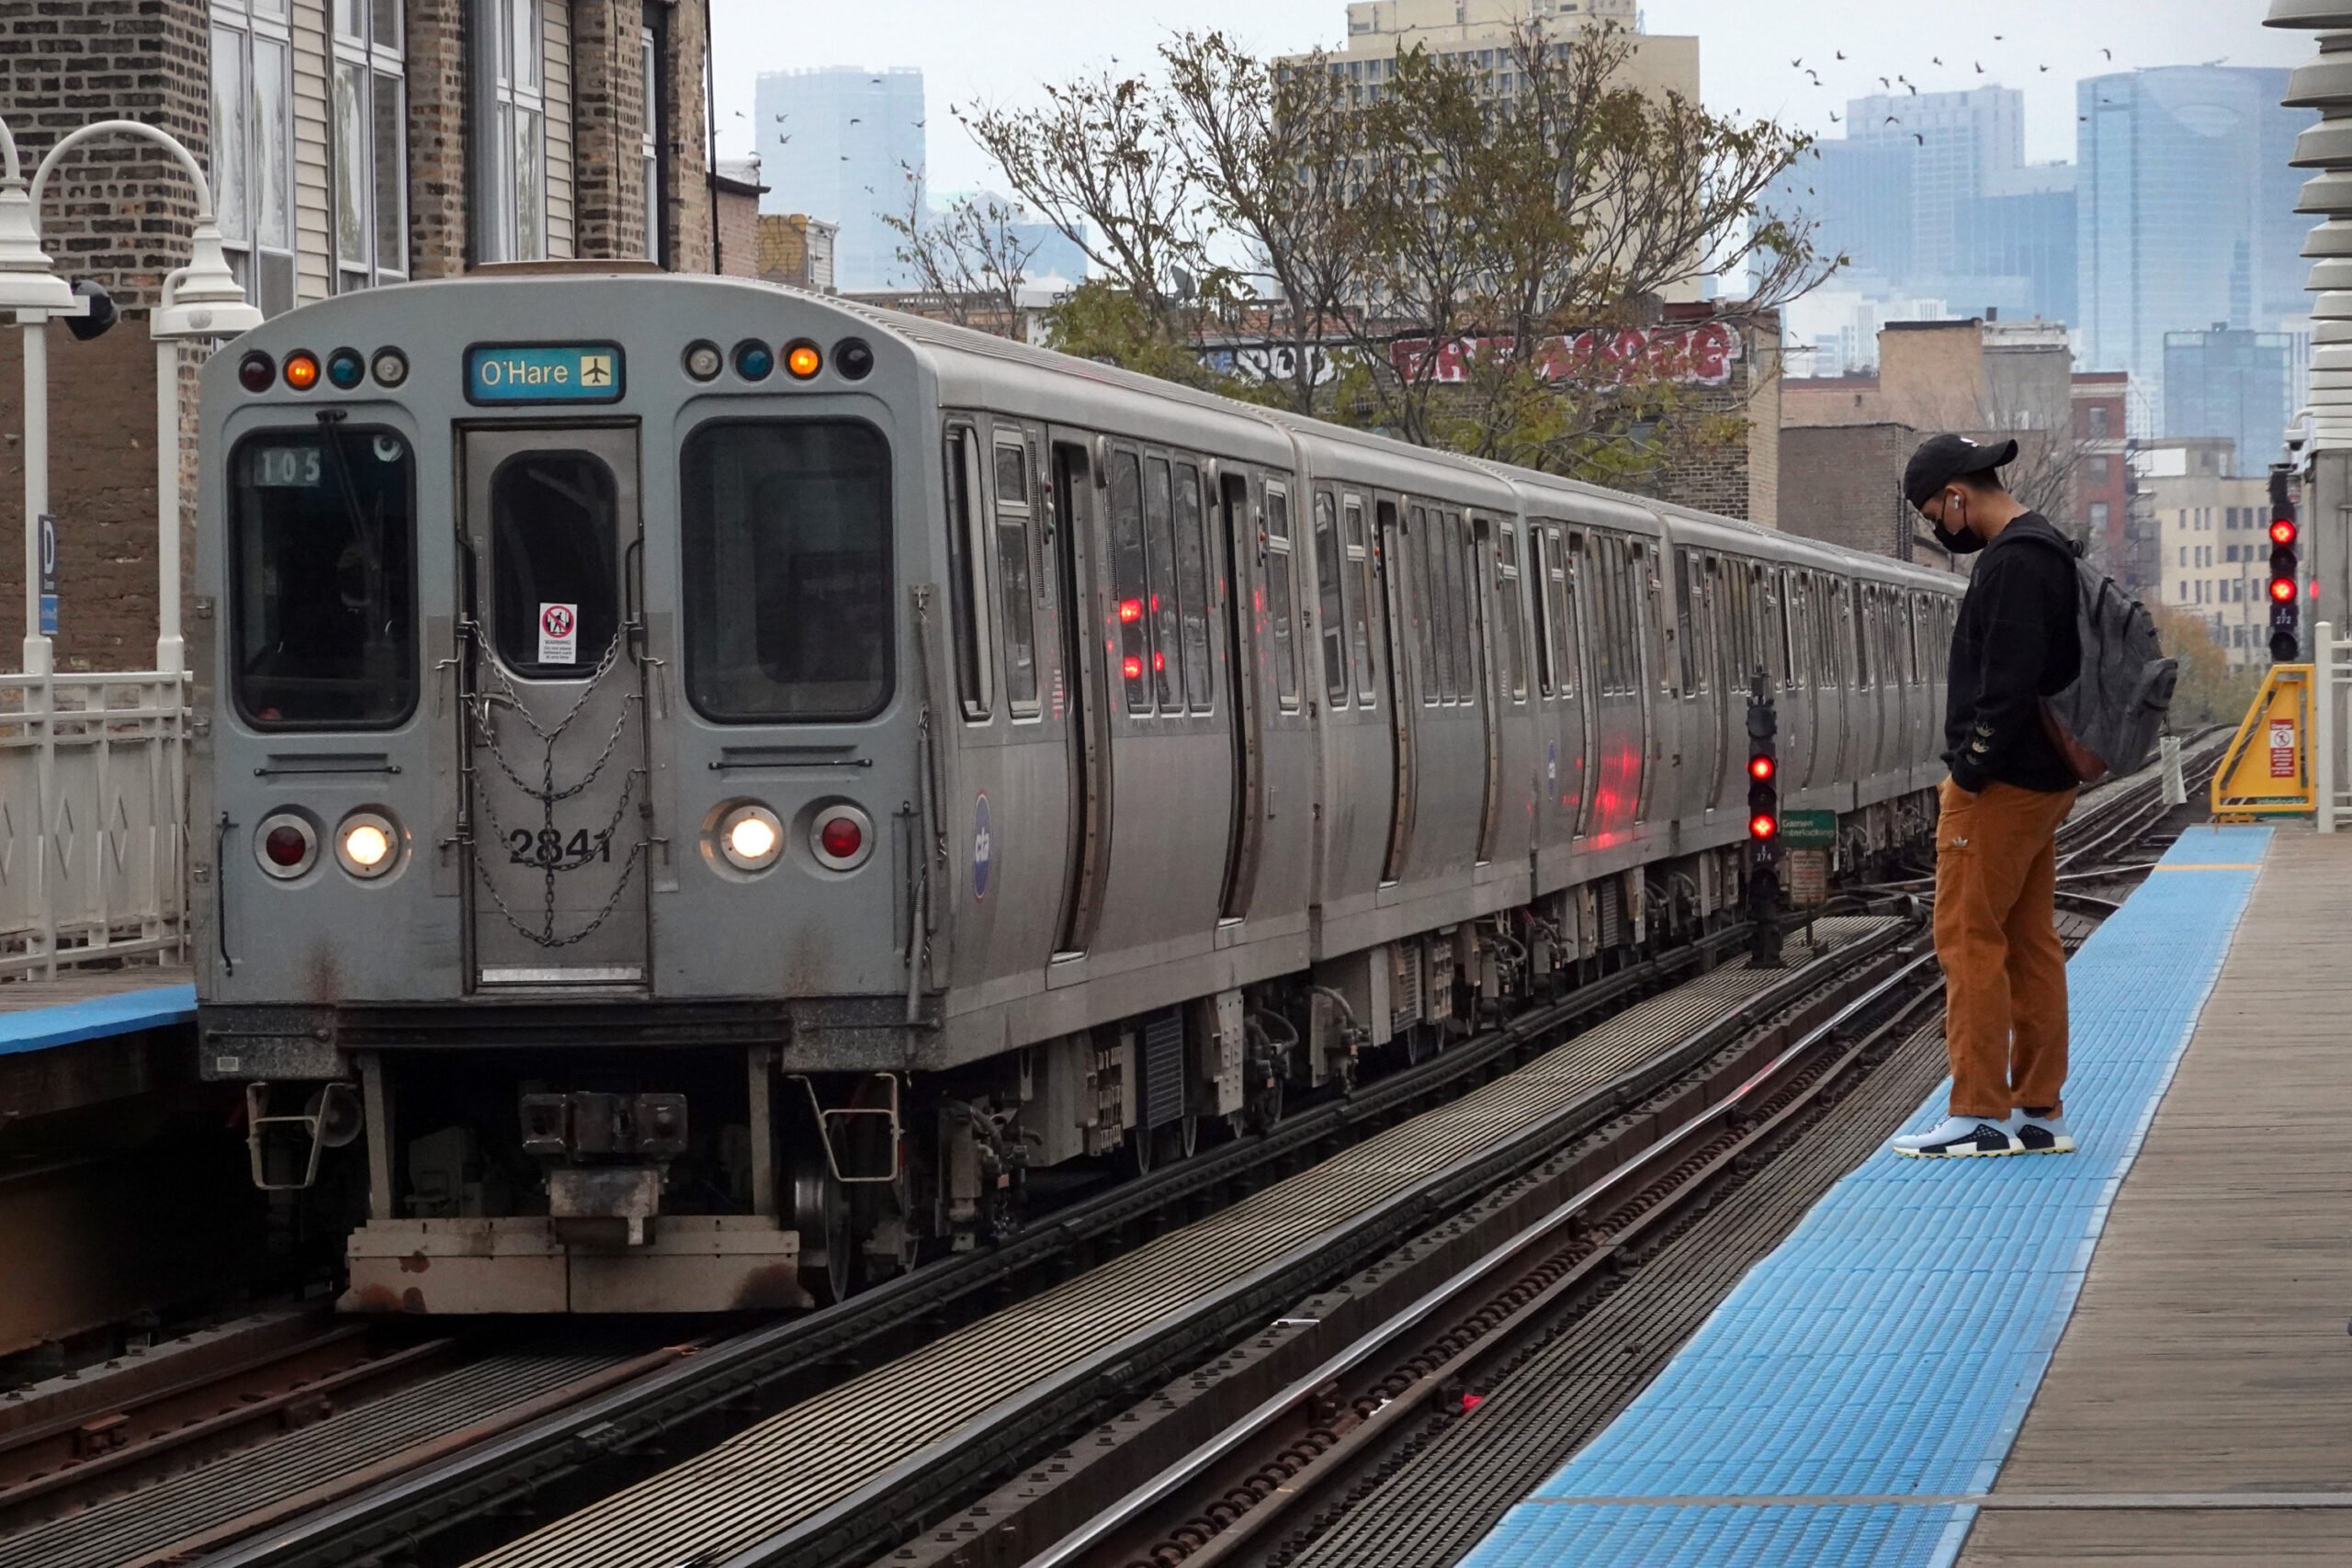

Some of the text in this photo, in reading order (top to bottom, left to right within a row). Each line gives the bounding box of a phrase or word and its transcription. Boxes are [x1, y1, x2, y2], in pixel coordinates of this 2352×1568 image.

[481, 360, 568, 386] O'Hare
[263, 451, 321, 481] 105
[43, 520, 55, 574] D
[510, 829, 611, 863] 2841
[975, 827, 990, 863] cta
[1757, 852, 1771, 862] 274
